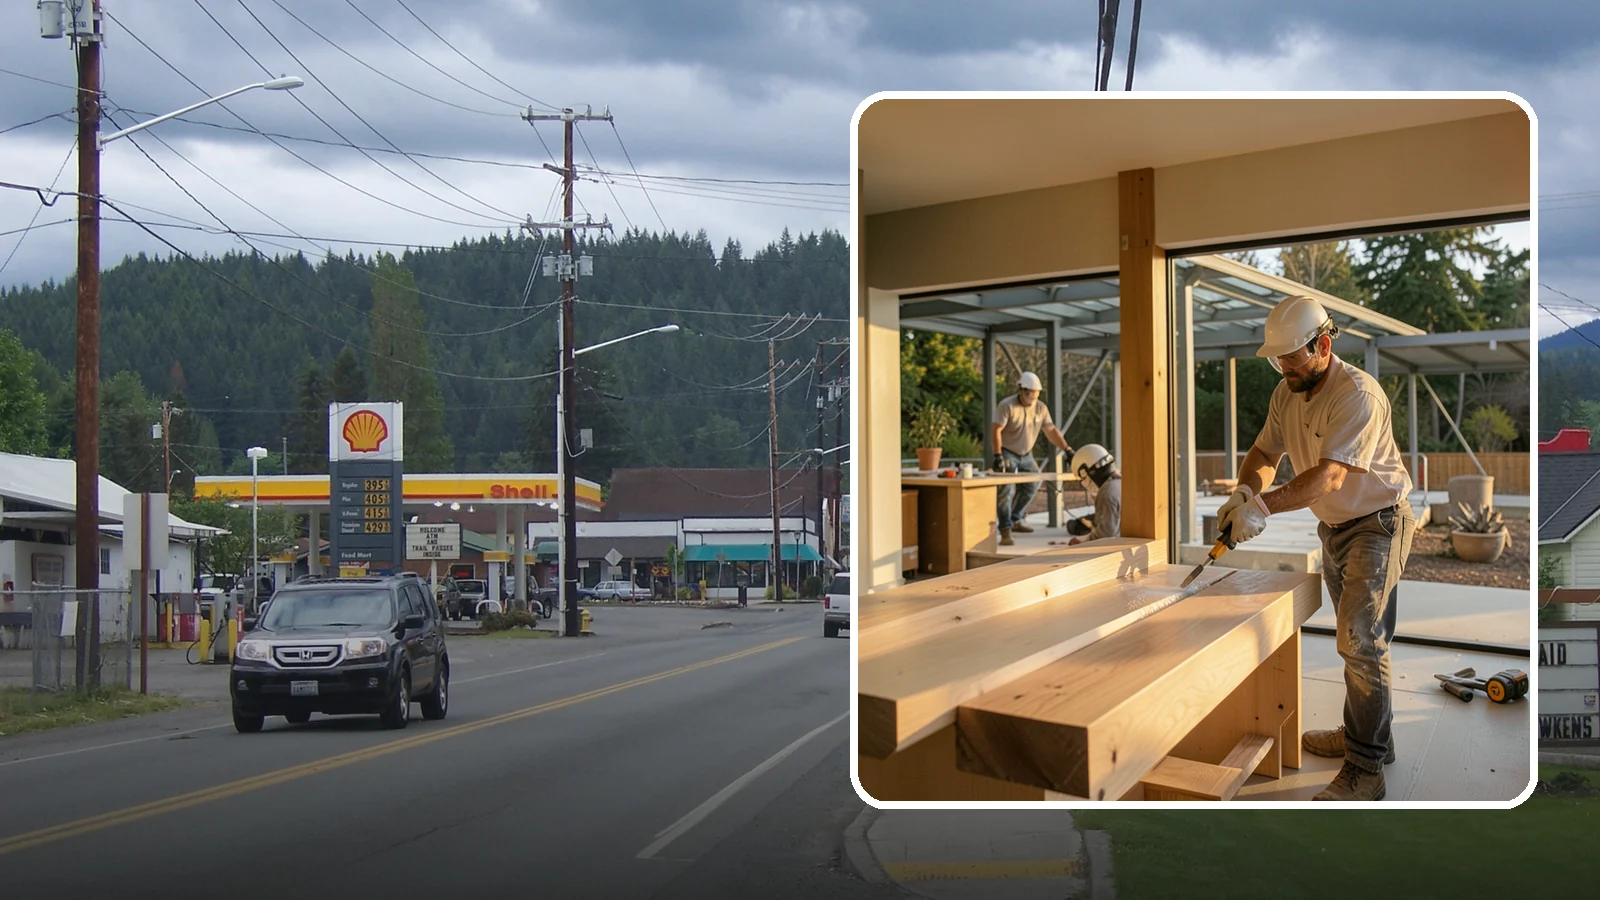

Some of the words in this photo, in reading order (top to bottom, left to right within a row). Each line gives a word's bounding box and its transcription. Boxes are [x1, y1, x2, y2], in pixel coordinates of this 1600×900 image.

[366, 480, 384, 490] 395
[490, 484, 547, 499] Shell
[366, 494, 384, 504] 405
[366, 508, 383, 518] 415
[366, 522, 384, 532] 429
